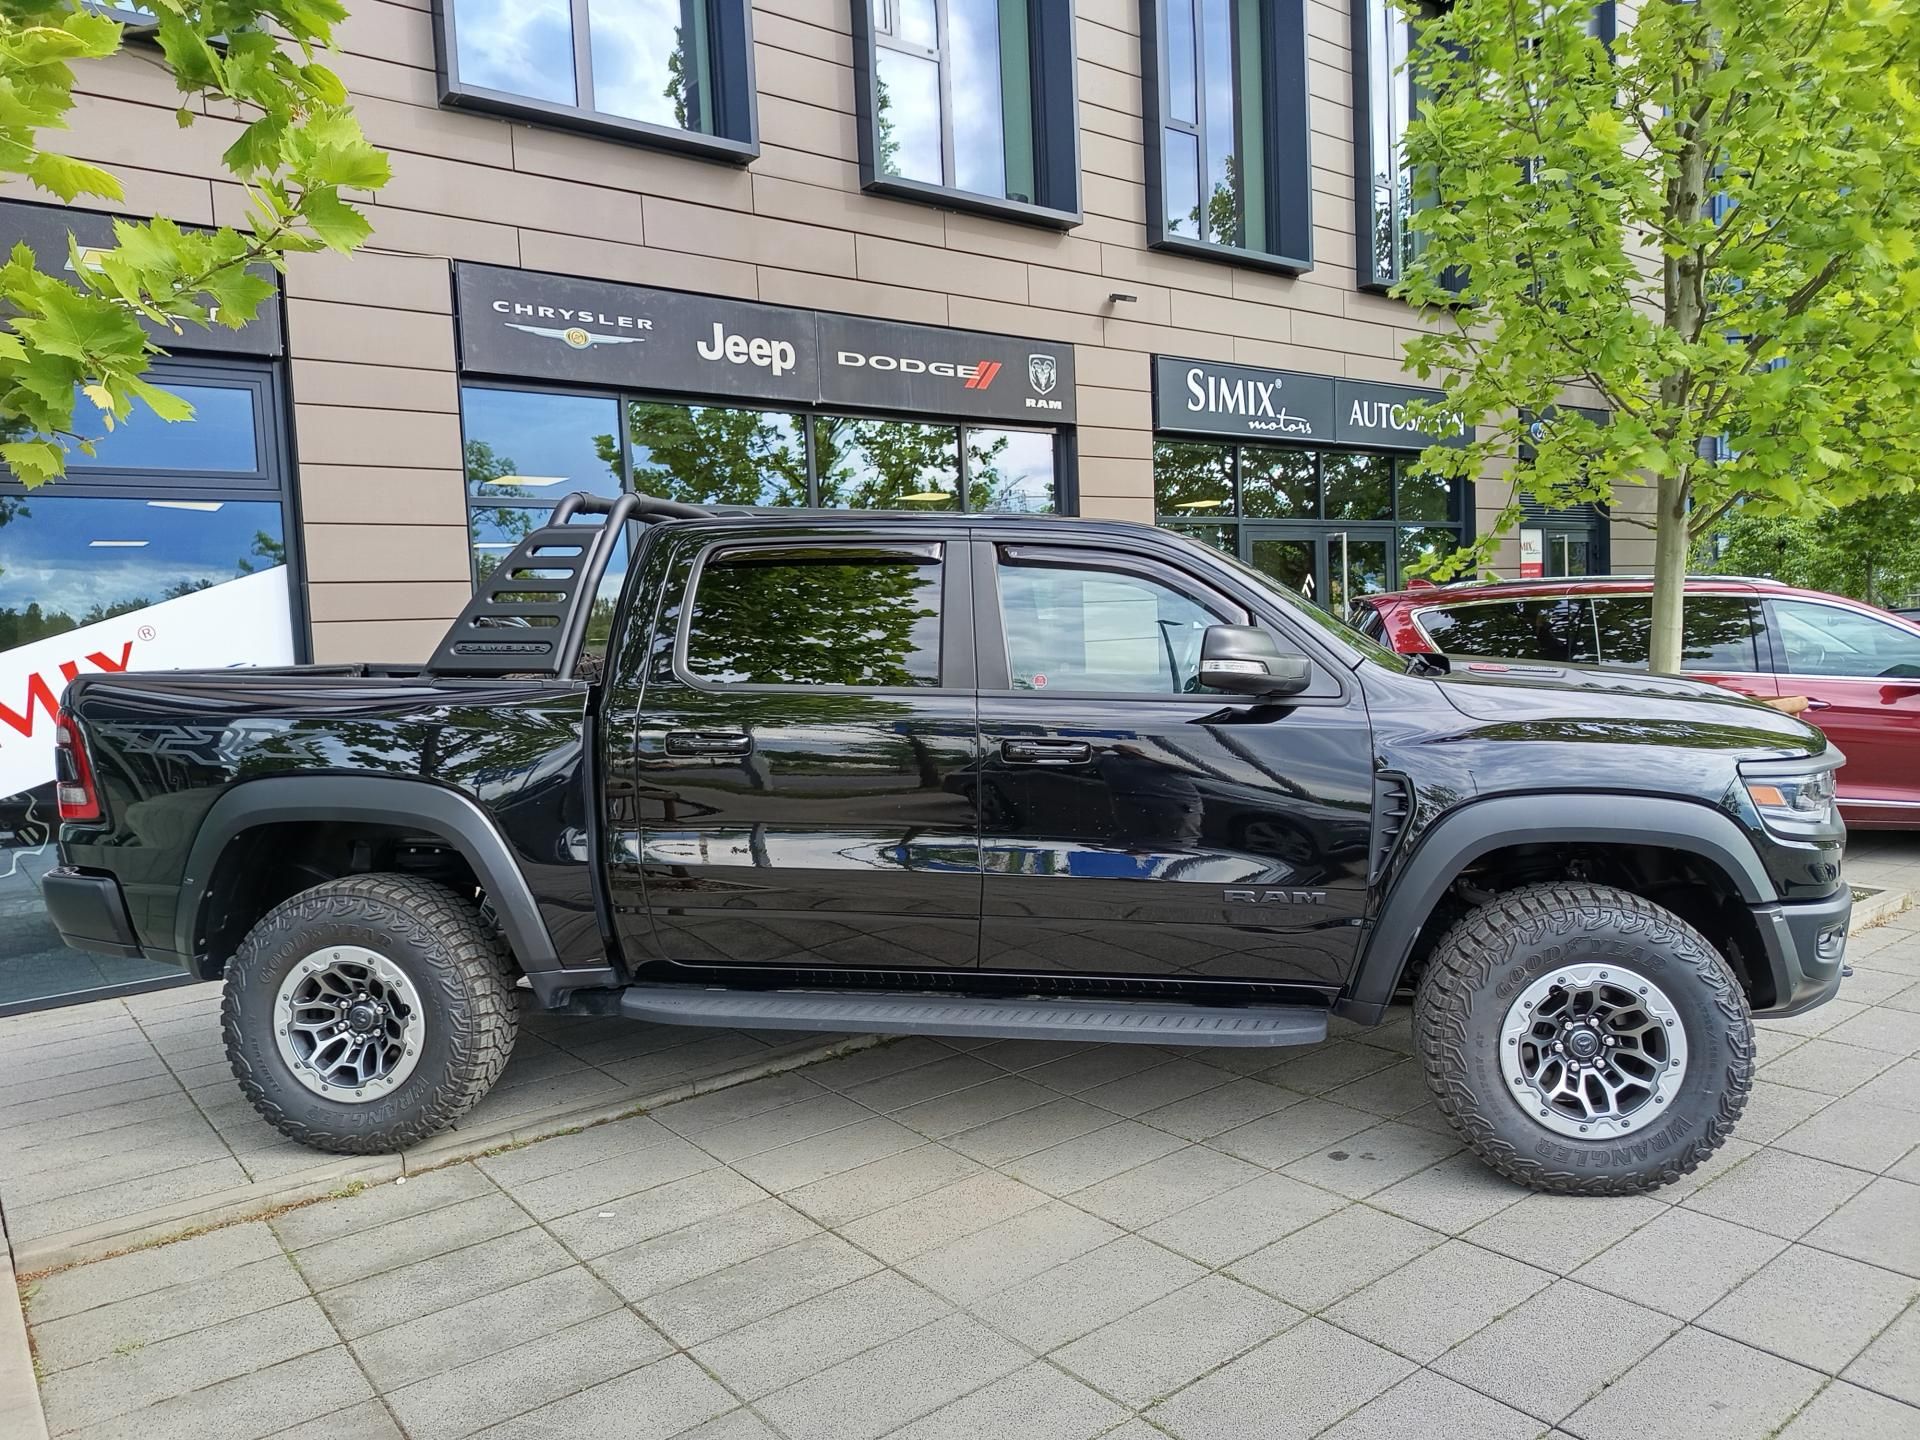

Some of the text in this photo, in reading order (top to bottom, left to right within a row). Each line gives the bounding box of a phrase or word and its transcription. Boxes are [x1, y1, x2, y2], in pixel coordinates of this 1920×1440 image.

[492, 300, 653, 330] CHRYSLER
[697, 323, 796, 376] Jeep
[837, 351, 980, 379] DODGE
[1025, 398, 1062, 410] RAM
[1349, 399, 1464, 435] AUTOON
[1248, 407, 1312, 434] motors
[1223, 889, 1326, 904] RAM
[1536, 1114, 1693, 1167] WRANGLER
